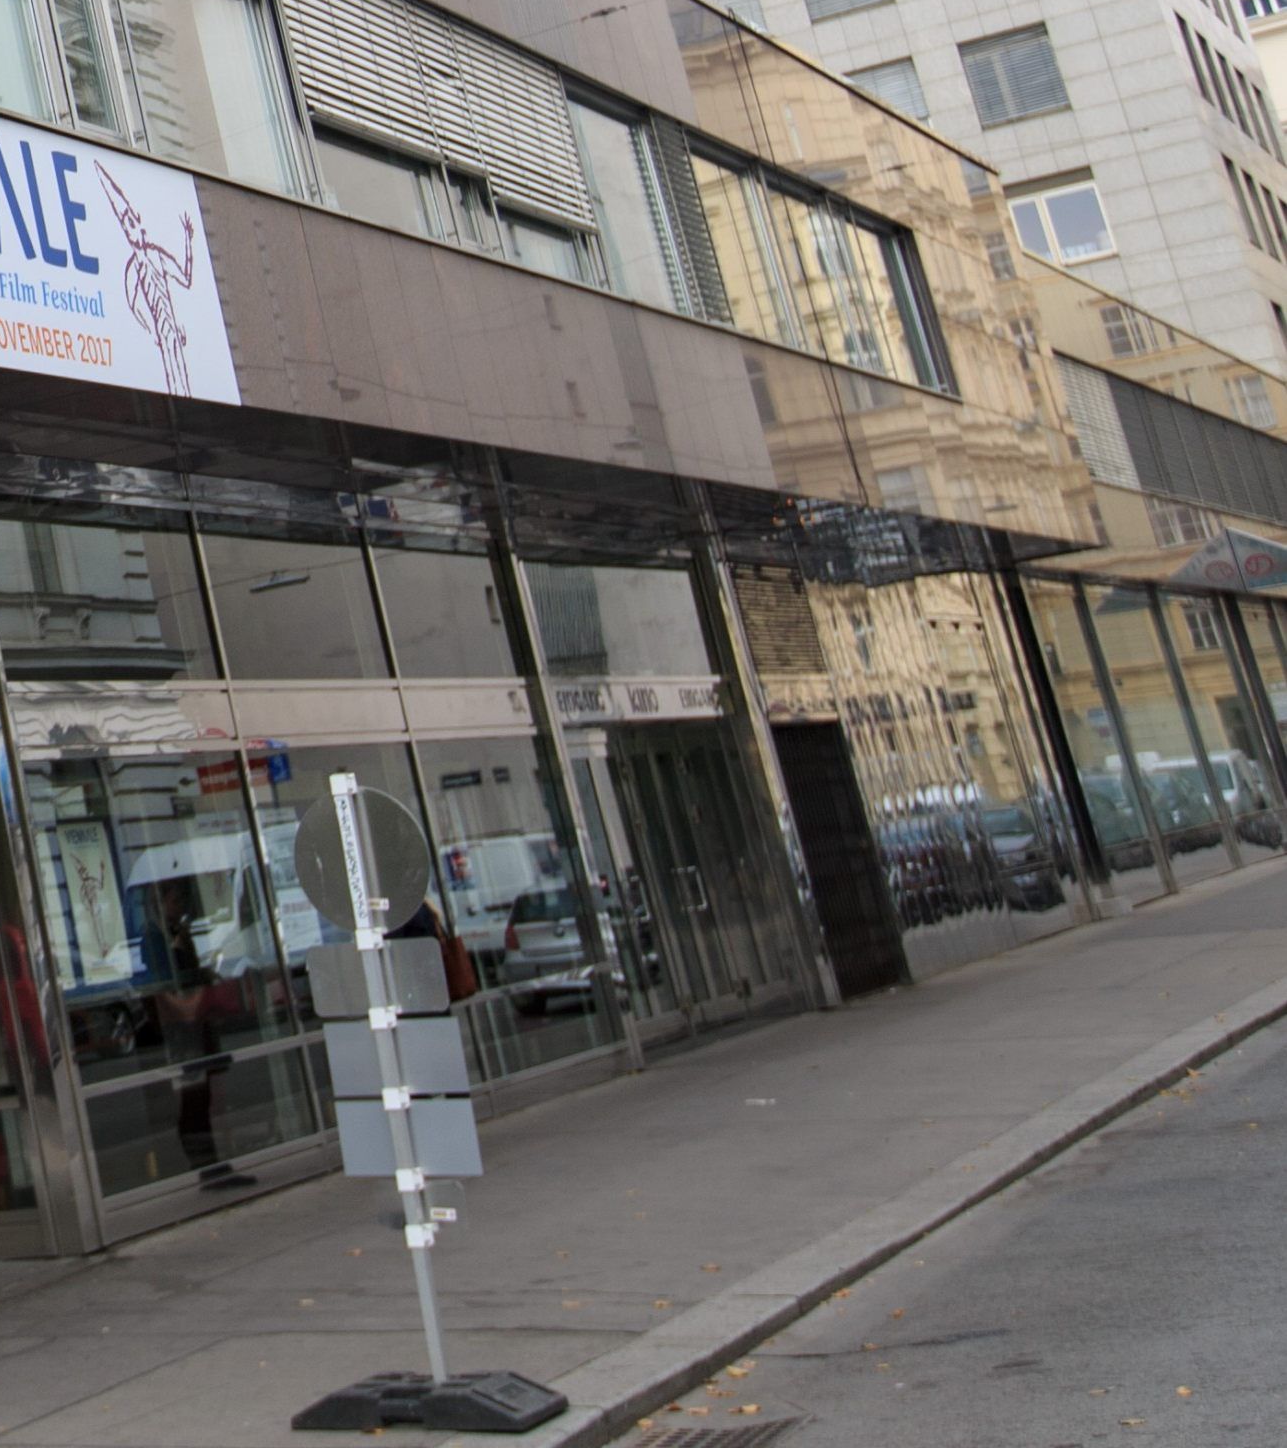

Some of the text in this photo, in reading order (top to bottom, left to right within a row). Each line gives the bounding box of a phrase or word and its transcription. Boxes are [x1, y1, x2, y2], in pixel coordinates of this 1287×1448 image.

[0, 271, 36, 304] Film
[41, 280, 106, 318] Festival
[77, 333, 113, 366] 2017
